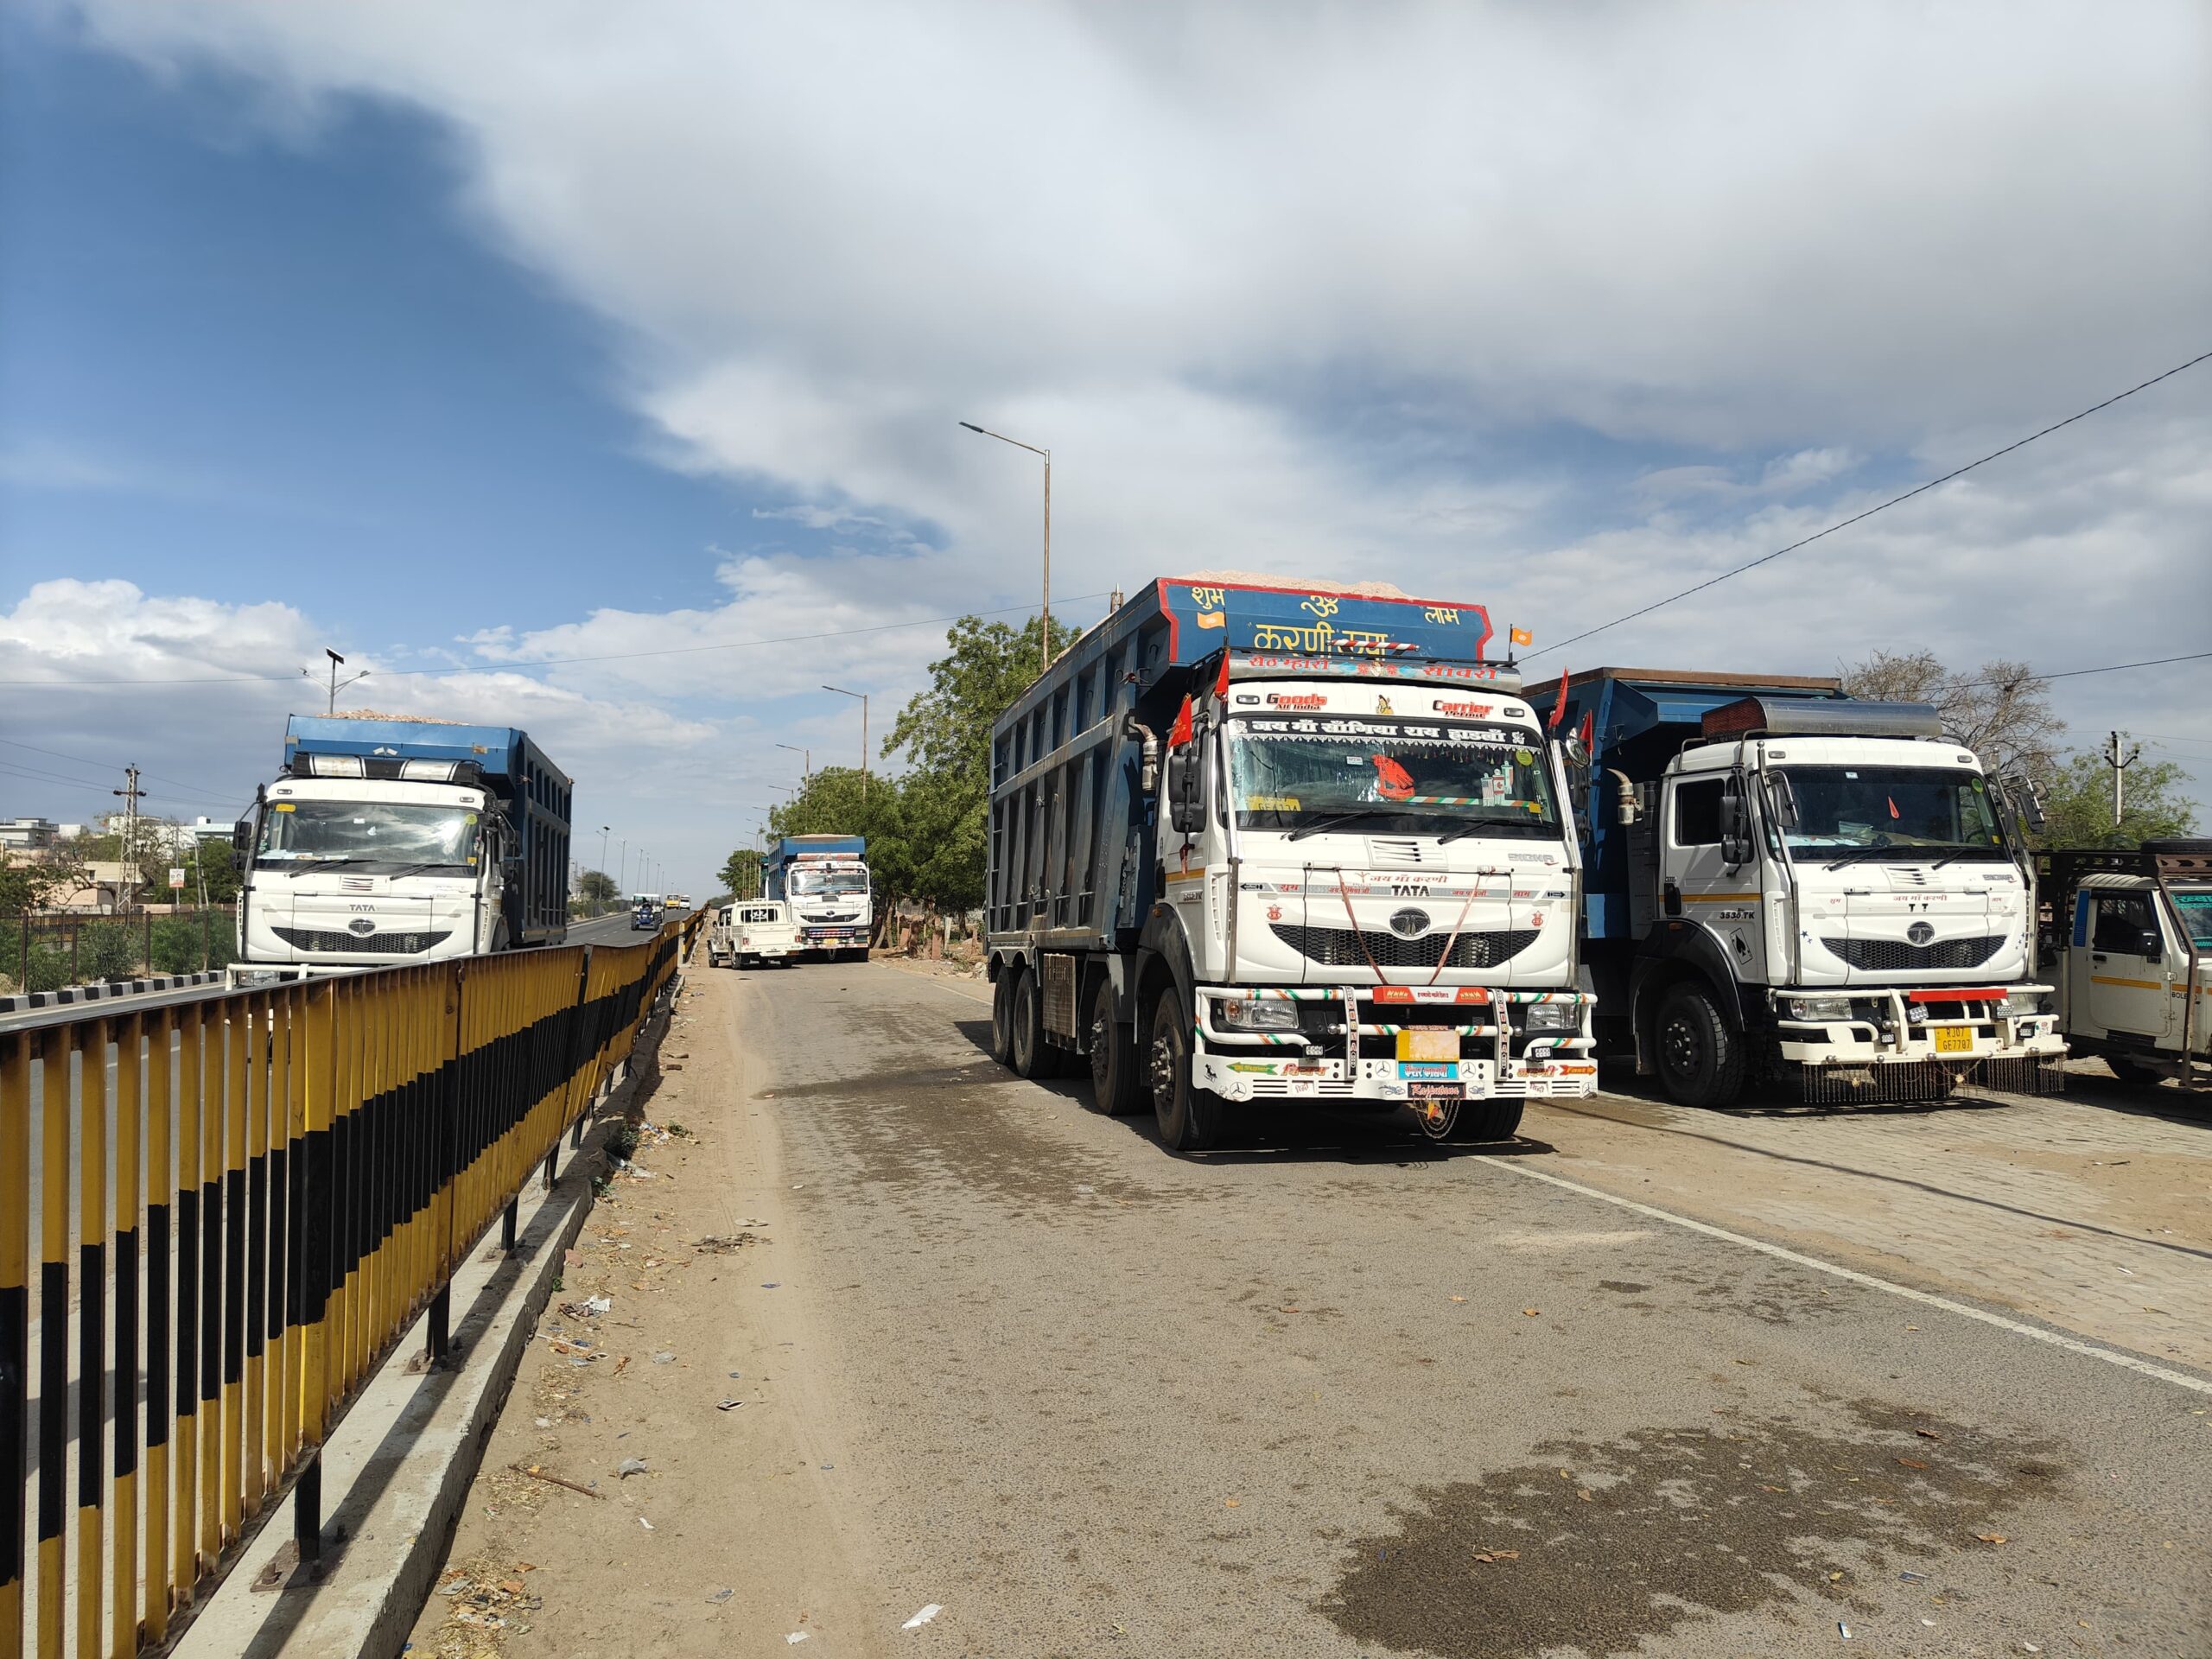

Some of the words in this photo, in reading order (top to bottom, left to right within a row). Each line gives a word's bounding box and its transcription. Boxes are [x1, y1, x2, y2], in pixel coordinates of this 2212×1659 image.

[1266, 693, 1328, 706] Goods
[1432, 700, 1494, 715] Carrier
[1444, 710, 1487, 719] Permit
[1252, 720, 1289, 732] जय
[1508, 852, 1554, 862] SIGNA
[1413, 874, 1448, 883] करणी
[1391, 885, 1430, 897] TATA
[1946, 1027, 1965, 1037] RJ07
